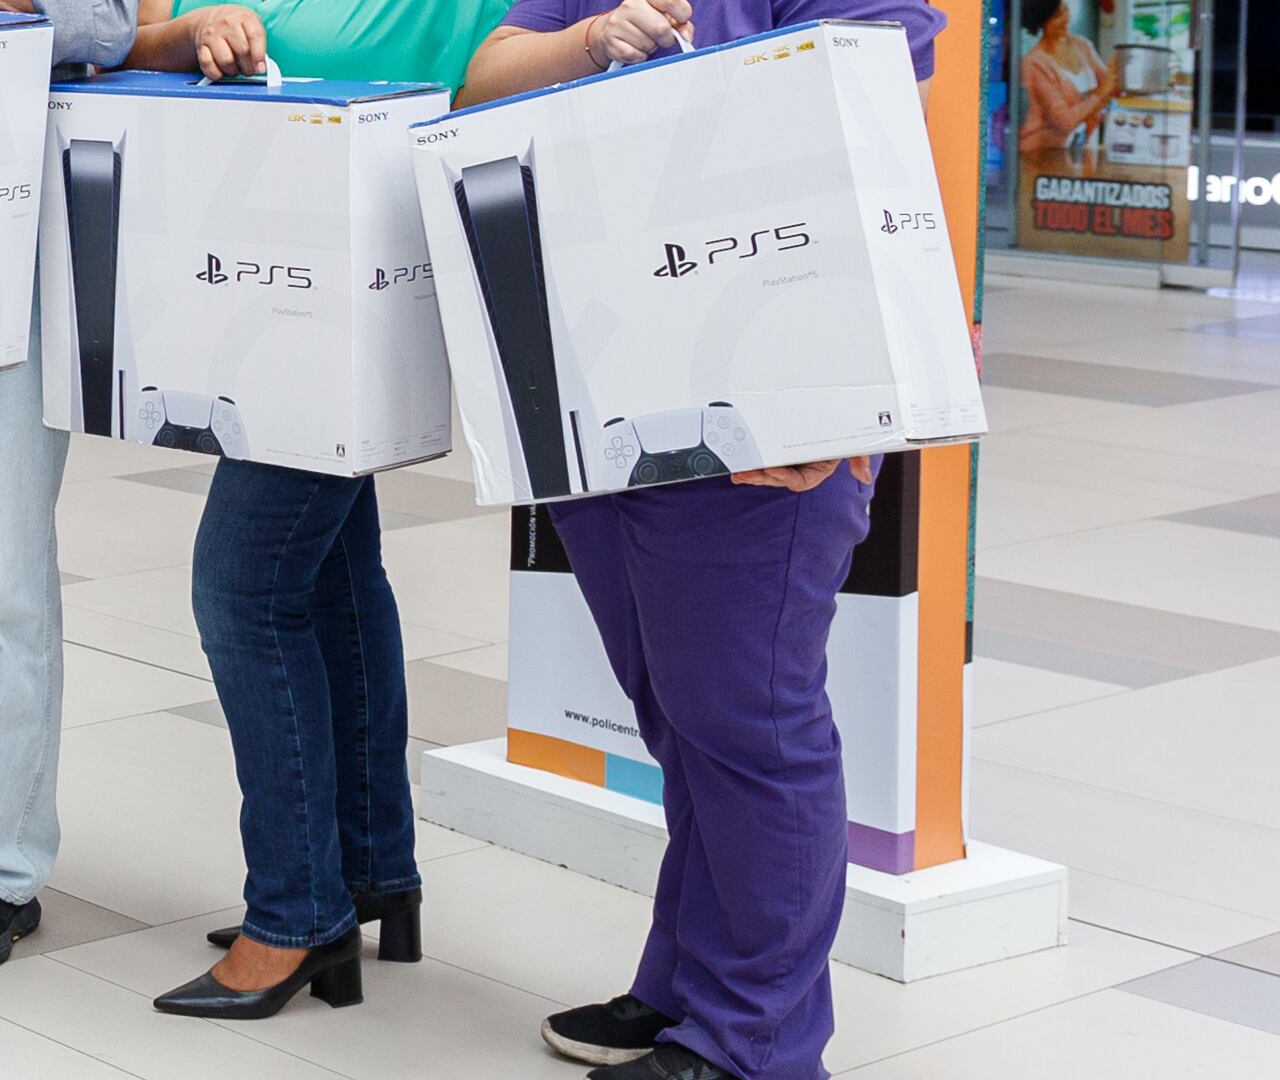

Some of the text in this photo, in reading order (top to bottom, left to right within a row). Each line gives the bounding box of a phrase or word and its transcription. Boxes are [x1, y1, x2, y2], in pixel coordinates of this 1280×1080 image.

[833, 36, 859, 48] SONY
[48, 101, 73, 111] ONY
[358, 111, 390, 124] SONY
[416, 128, 460, 146] SONY
[1036, 177, 1170, 209] GARANTIZADOS
[899, 212, 936, 230] PS5
[1093, 205, 1115, 234] EL
[1121, 208, 1173, 239] MES
[705, 223, 810, 264] PS5
[237, 261, 312, 289] PS5
